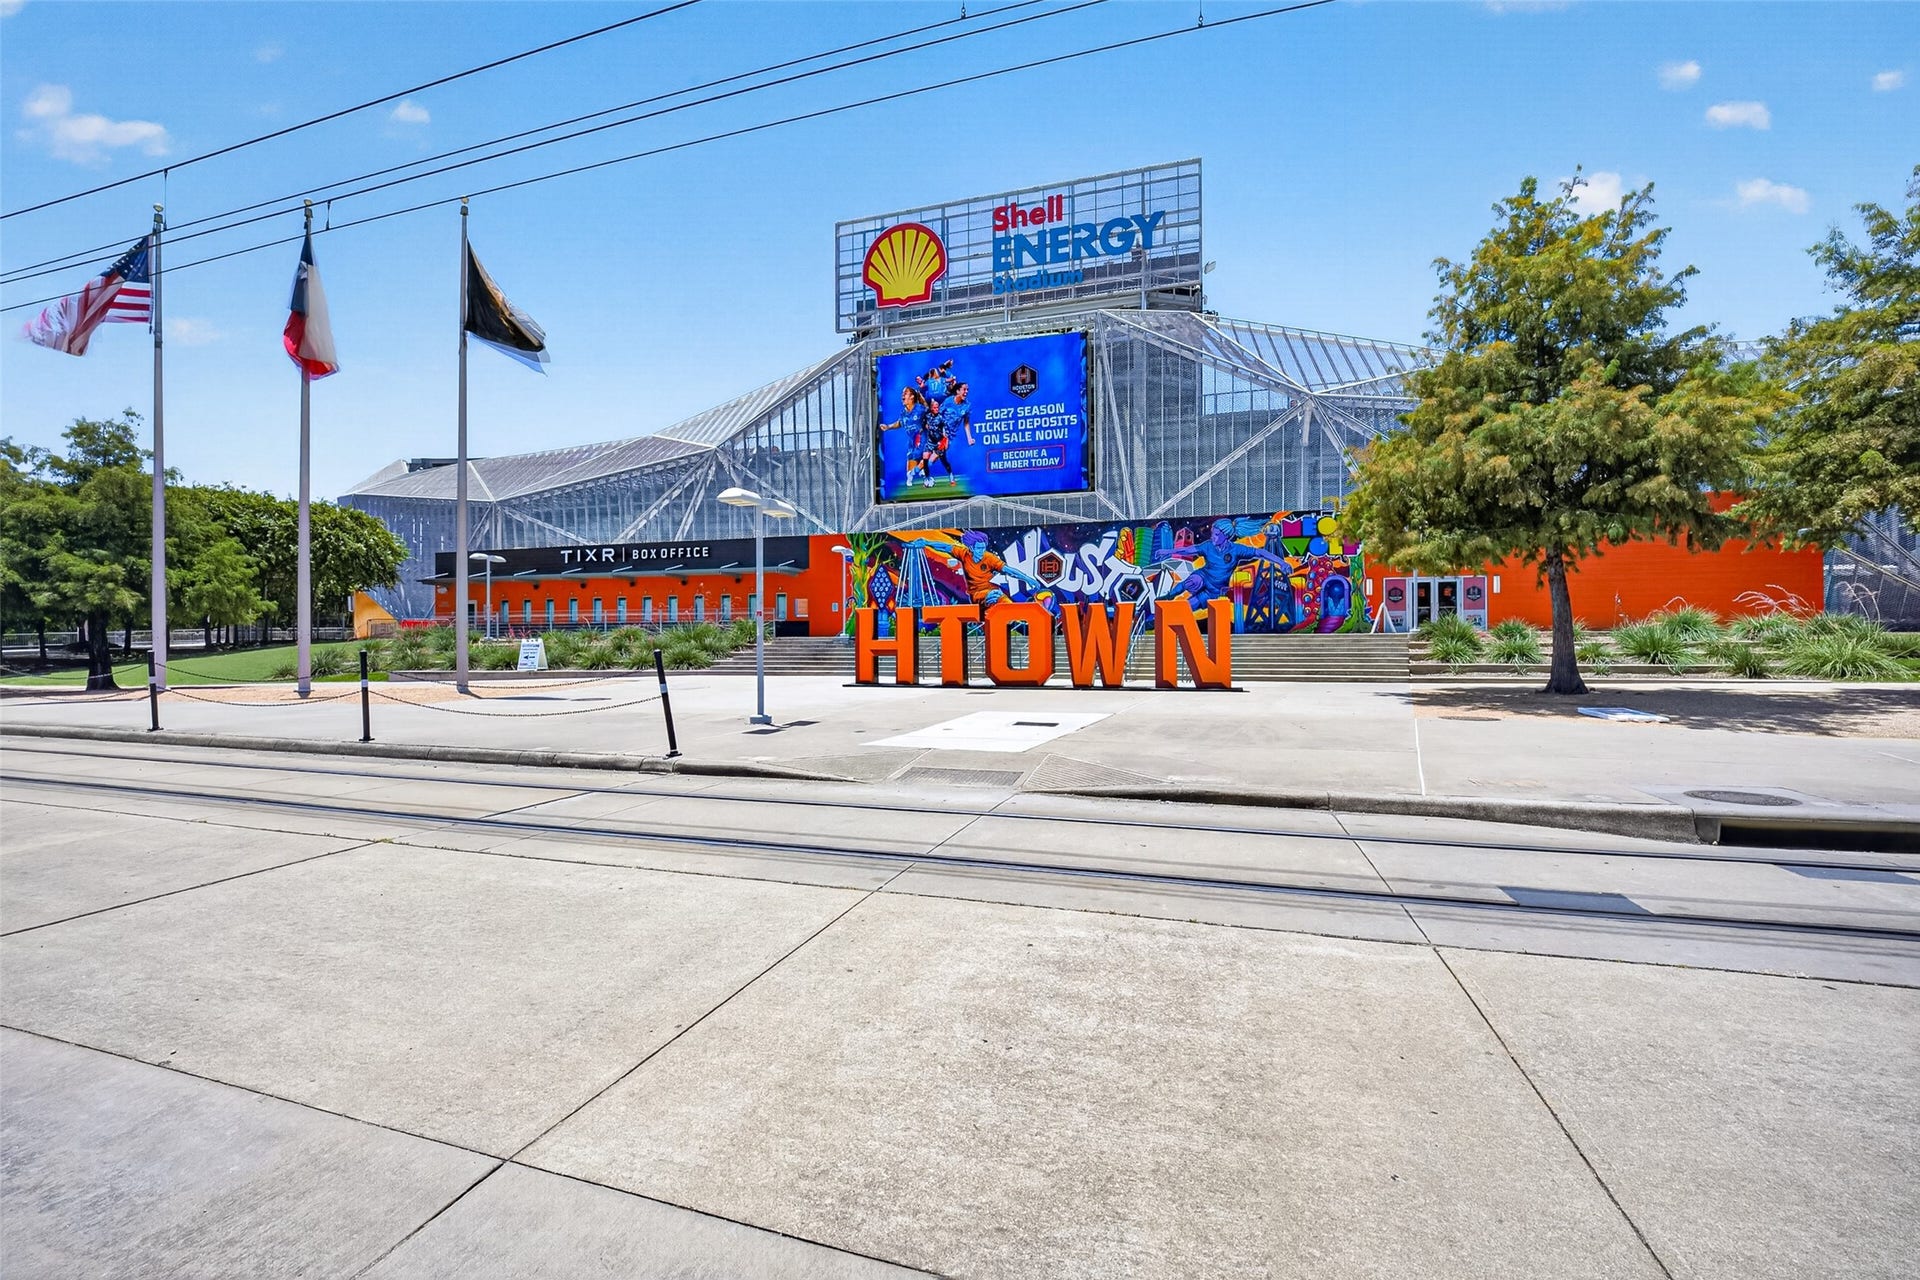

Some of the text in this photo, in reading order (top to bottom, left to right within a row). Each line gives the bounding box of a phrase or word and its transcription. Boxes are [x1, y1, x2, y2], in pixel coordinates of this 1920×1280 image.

[992, 194, 1063, 231] Shell
[992, 210, 1166, 272] ENERGY
[992, 267, 1084, 295] Stadium
[985, 403, 1065, 420] 2027 SEASON
[974, 414, 1078, 433] TICKET DEPOSITS
[983, 428, 1068, 445] ON SALE NOW!
[990, 457, 1060, 470] MEMBER TODAY
[1002, 449, 1048, 460] BECOME A
[560, 546, 710, 564] TIXR BOX OFFICE
[855, 599, 1231, 689] HTOWN
